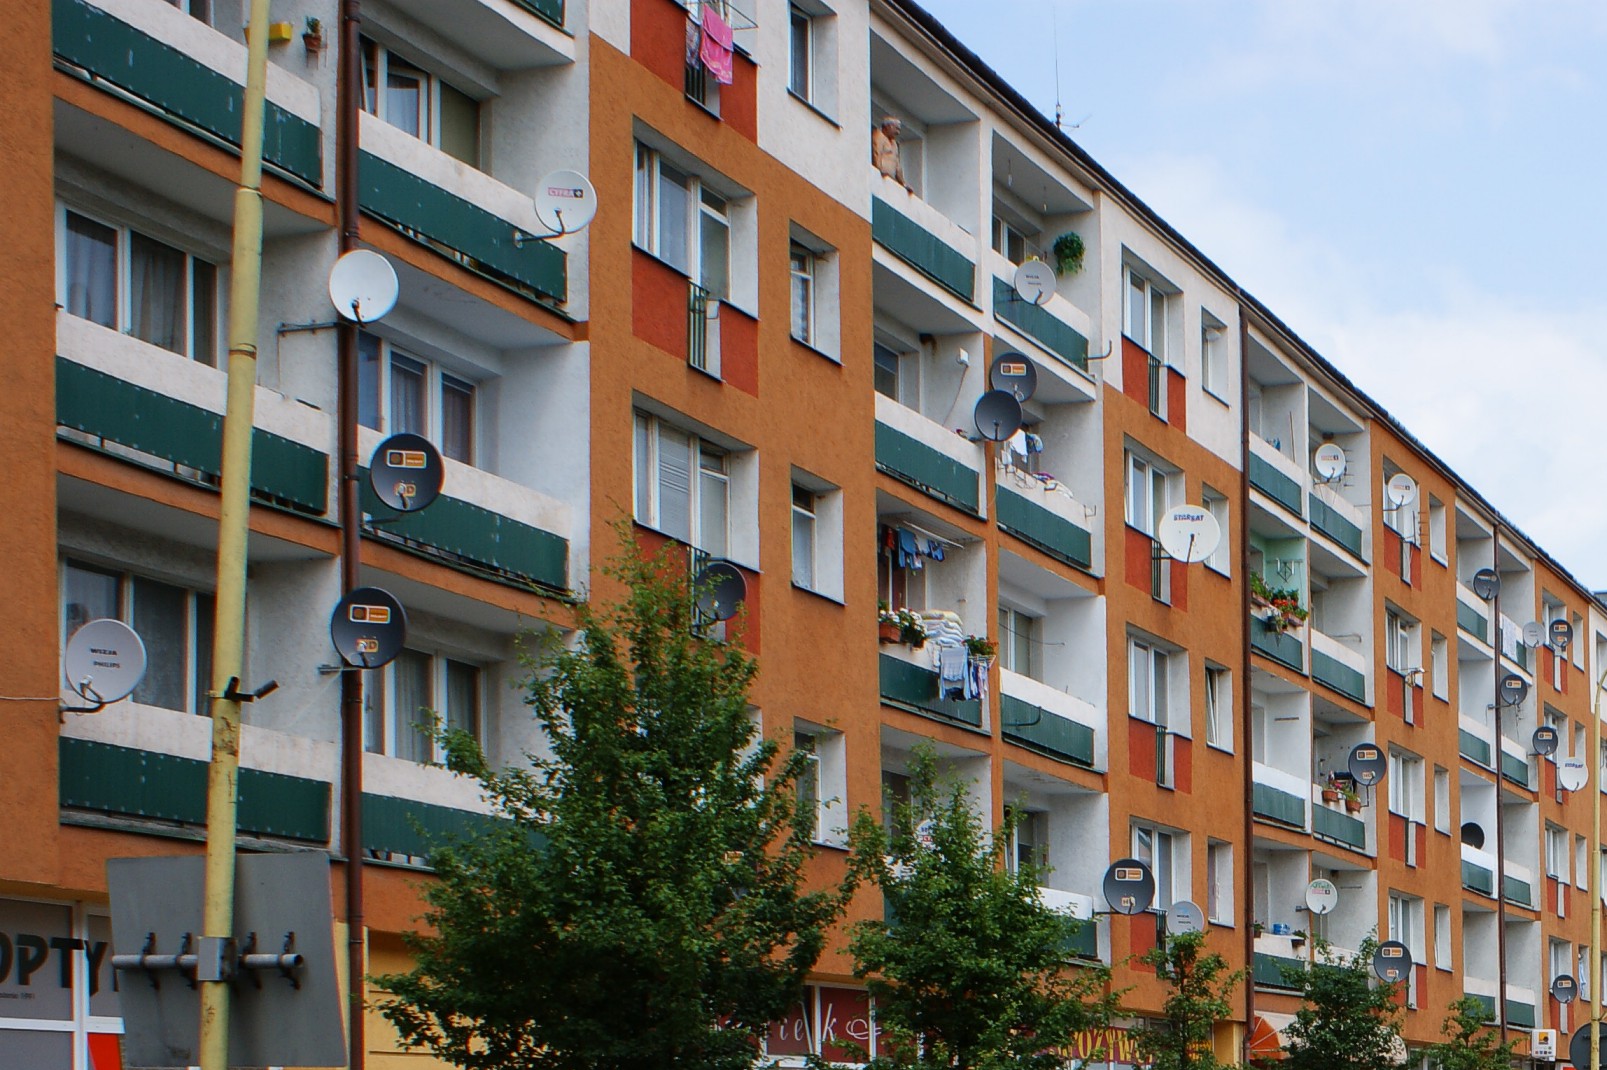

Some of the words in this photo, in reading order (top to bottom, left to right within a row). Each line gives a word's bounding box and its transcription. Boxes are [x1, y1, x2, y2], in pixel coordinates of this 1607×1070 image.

[90, 648, 118, 656] WIZJA
[93, 661, 121, 669] PHILIPS
[0, 932, 119, 997] OPTY
